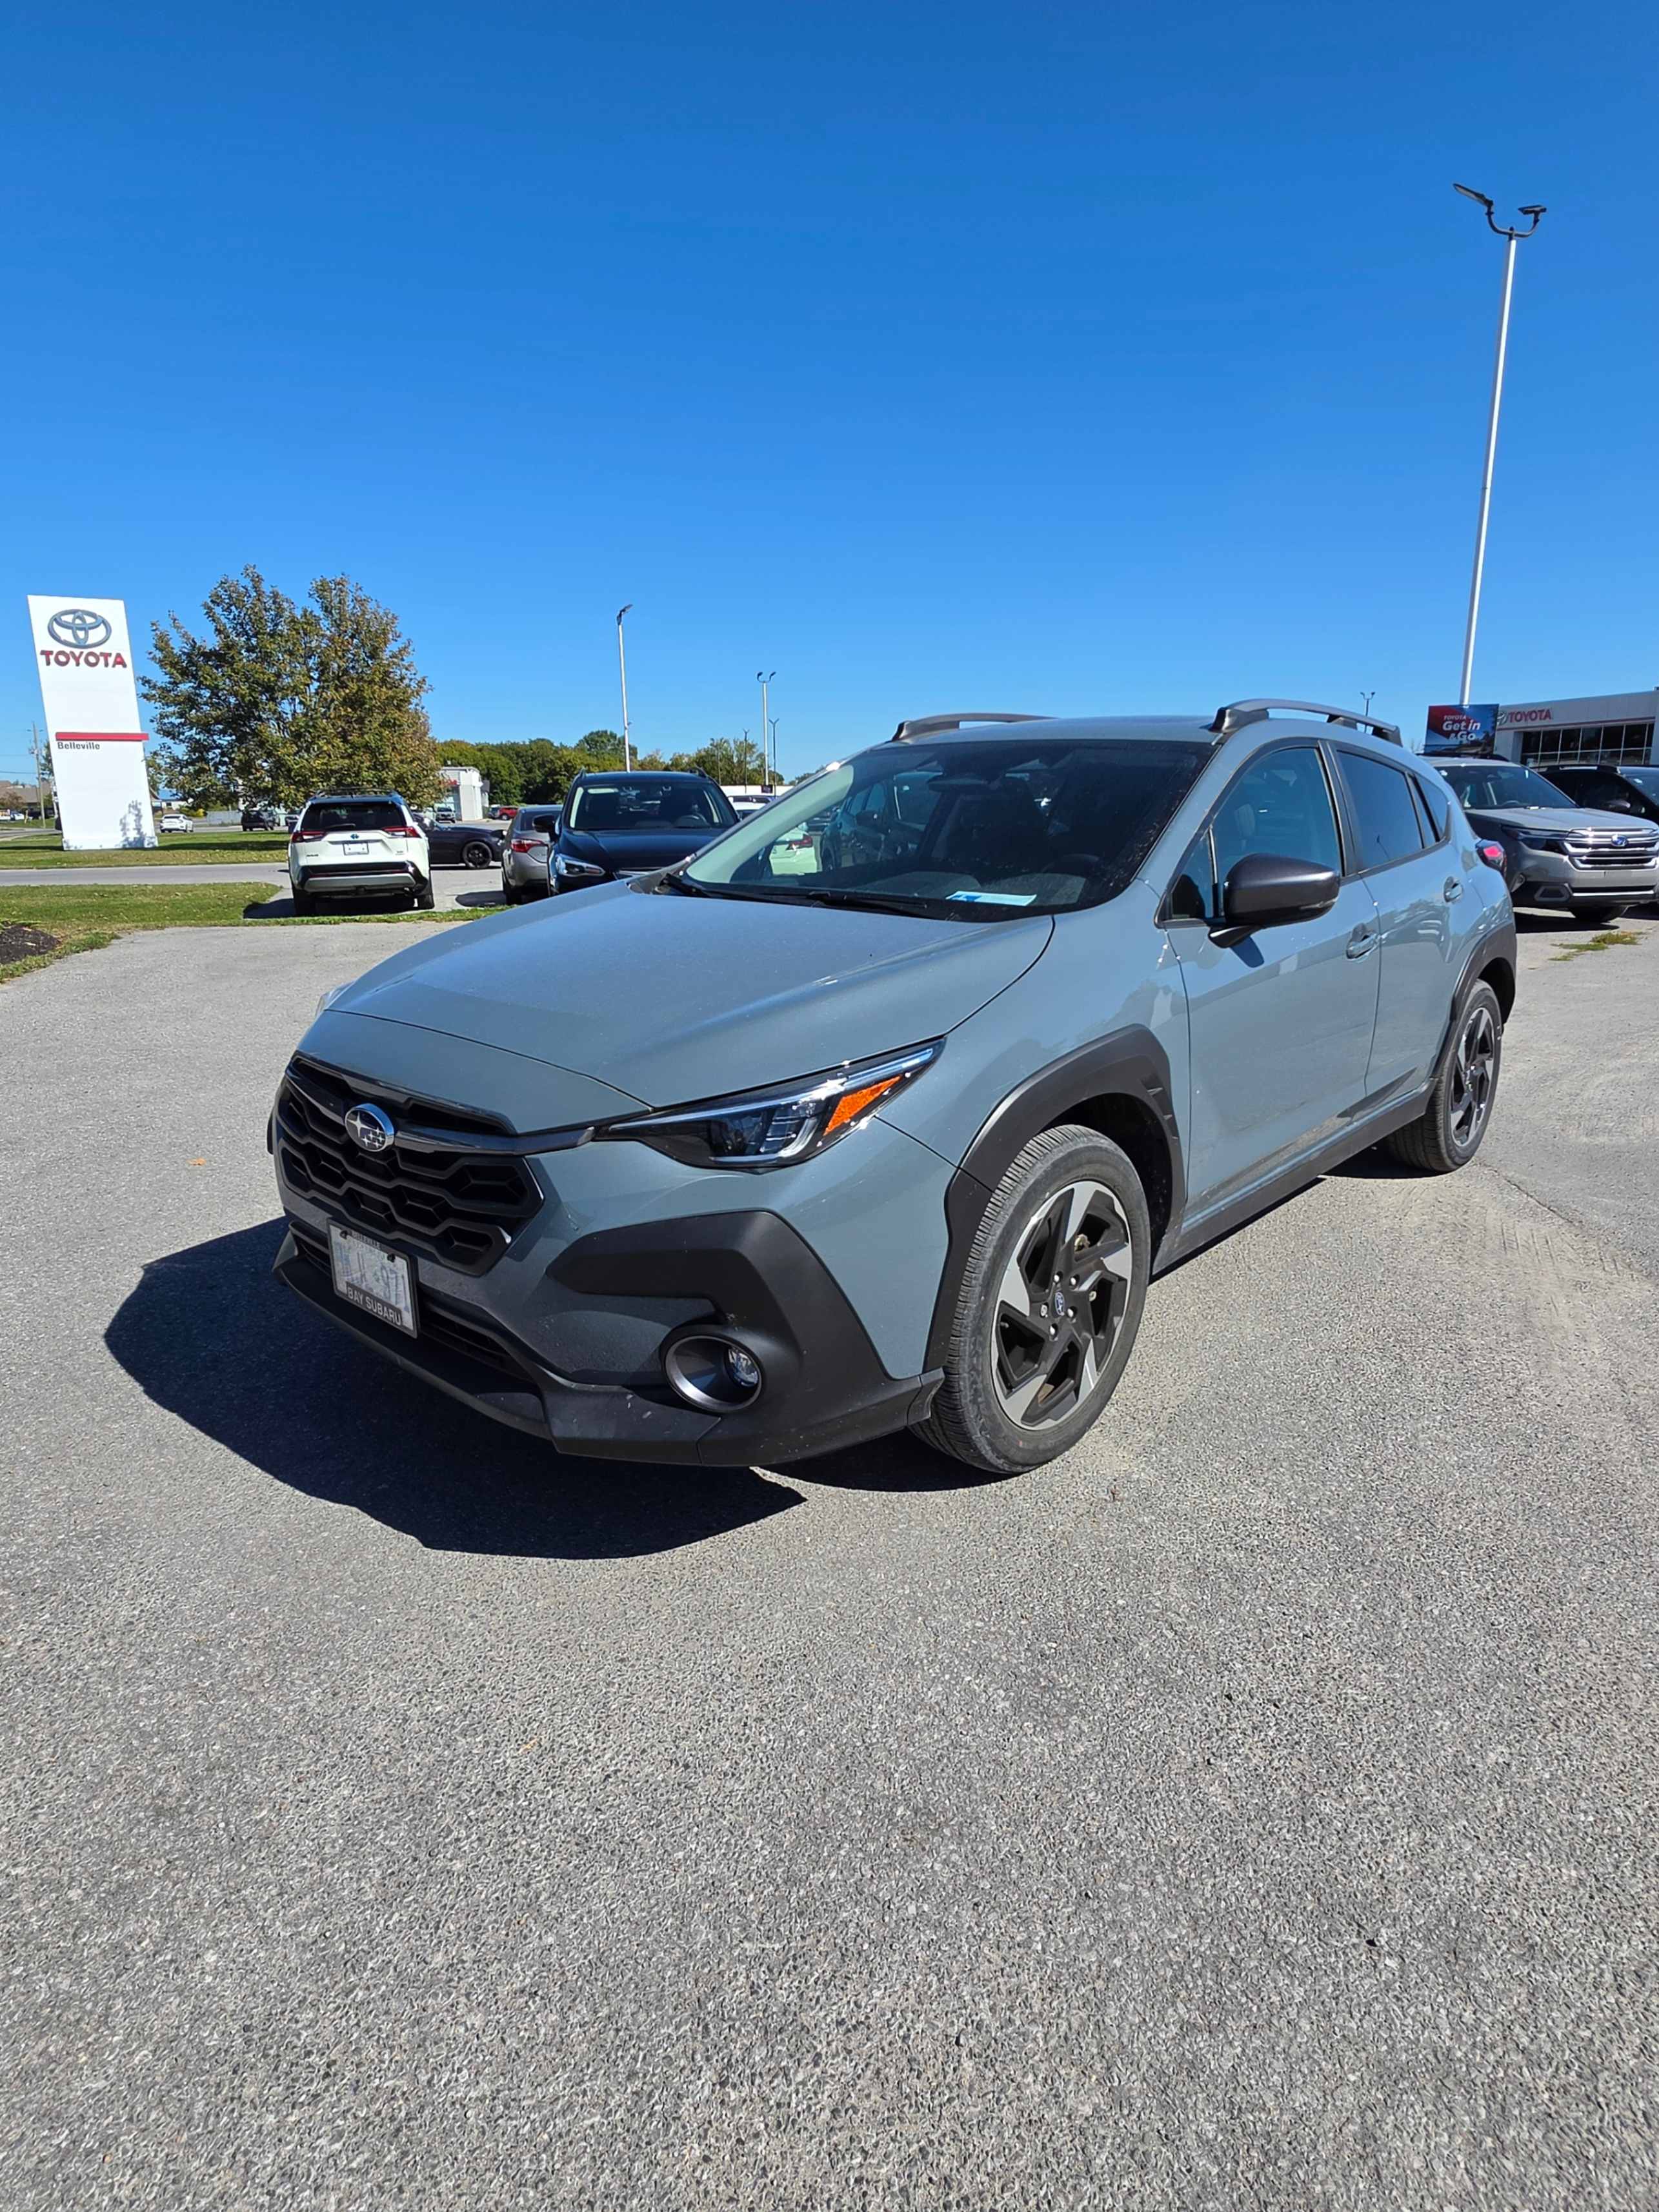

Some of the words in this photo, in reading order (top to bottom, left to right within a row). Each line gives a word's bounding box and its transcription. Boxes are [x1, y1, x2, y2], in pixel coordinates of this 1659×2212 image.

[40, 650, 127, 668] TOYOTA
[1509, 710, 1551, 722] TOYOTA
[1442, 721, 1467, 731] Get
[1468, 719, 1481, 731] in
[57, 742, 101, 750] Belleville
[347, 1286, 363, 1306] BAY
[366, 1297, 401, 1326] SUBARU
